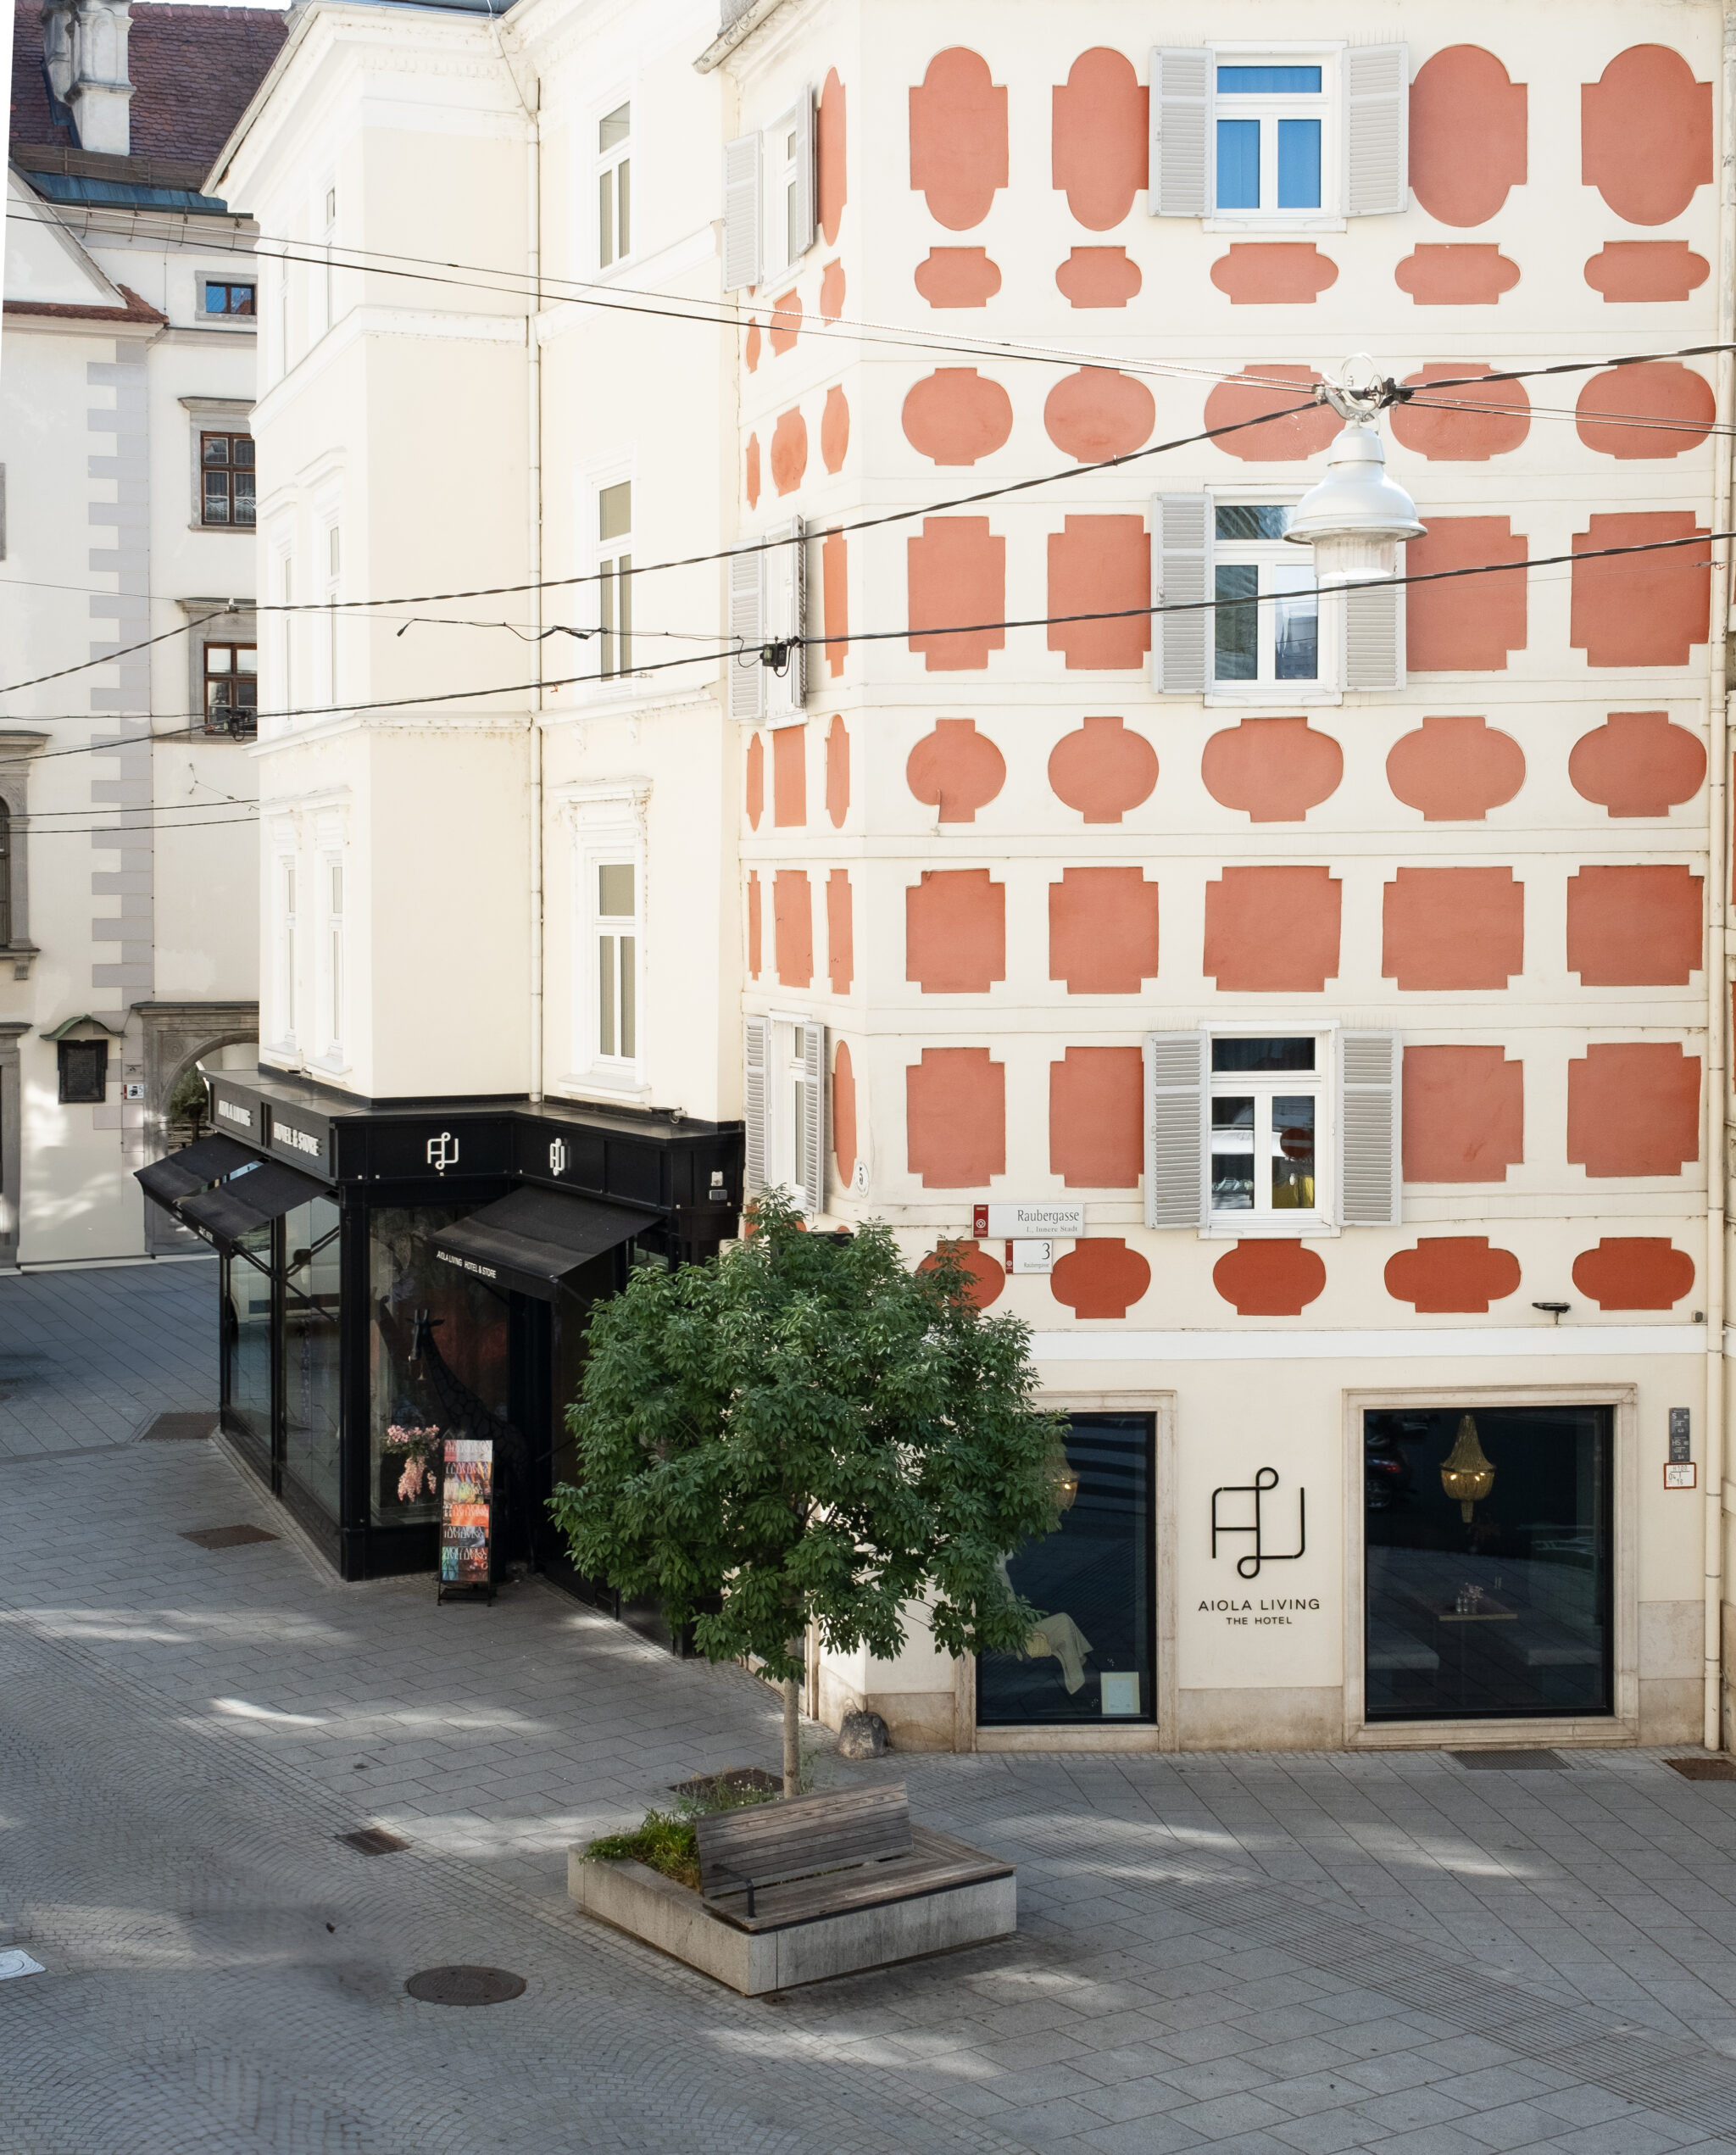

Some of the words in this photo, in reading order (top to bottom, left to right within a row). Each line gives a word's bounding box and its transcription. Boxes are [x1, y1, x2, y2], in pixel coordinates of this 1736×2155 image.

[1016, 1209, 1080, 1225] Raubergasse
[1041, 1242, 1050, 1260] 3
[448, 1255, 463, 1267] LIVING
[464, 1261, 478, 1272] HOTEL
[481, 1267, 497, 1278] STORE
[1198, 1600, 1253, 1612] AIOLA
[1260, 1598, 1321, 1611] LIVING
[1226, 1617, 1249, 1625] THE
[1255, 1616, 1293, 1625] HOTEL
